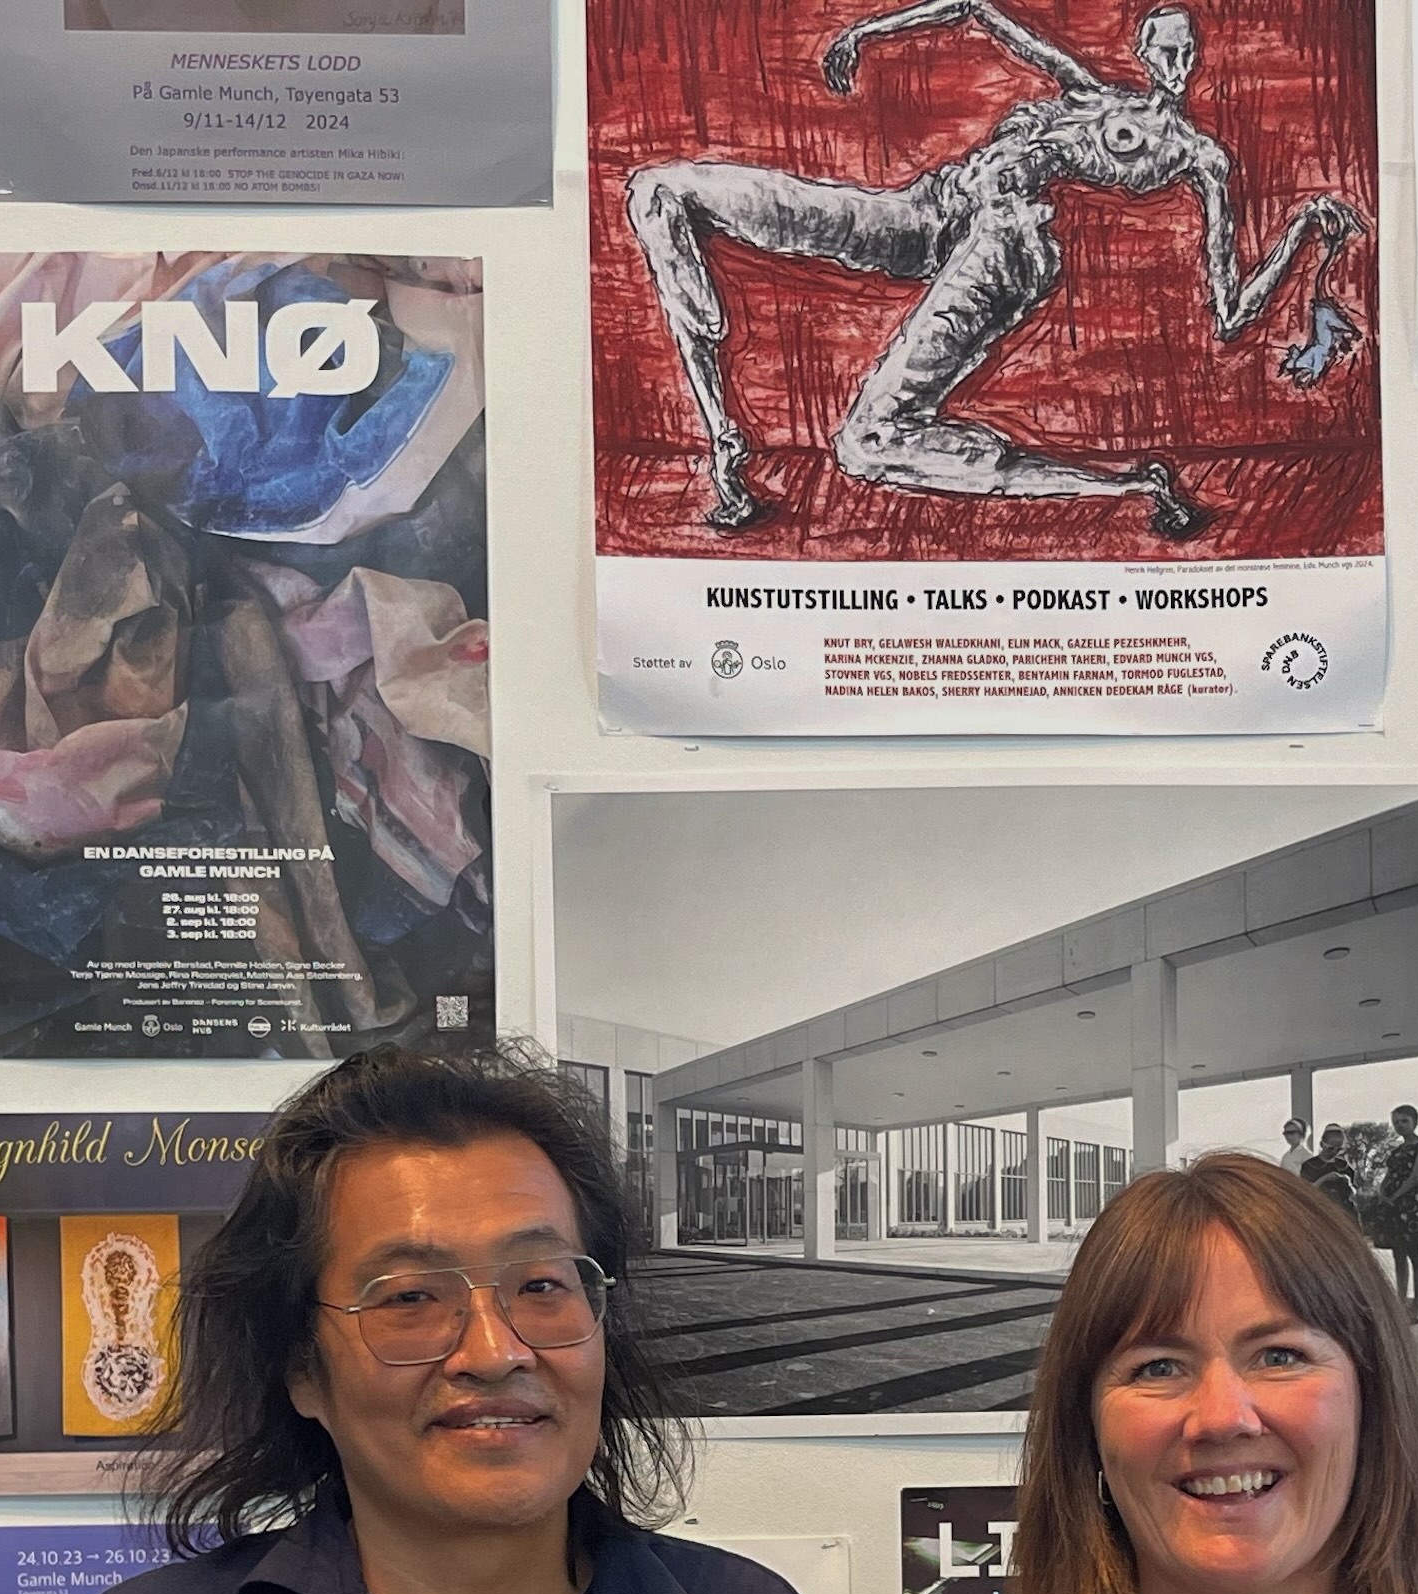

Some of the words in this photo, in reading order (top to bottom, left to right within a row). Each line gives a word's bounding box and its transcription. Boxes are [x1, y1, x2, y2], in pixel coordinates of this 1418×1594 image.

[171, 53, 300, 71] MENNESKETS
[307, 55, 361, 72] LODD
[133, 83, 152, 100] På
[159, 84, 212, 100] Gamle
[219, 85, 278, 104] Munch,
[286, 87, 373, 106] Tøyengata
[379, 88, 399, 103] 53
[21, 299, 380, 399] KNØ
[707, 588, 898, 611] KUNSTUTSTILLING
[924, 589, 987, 610] TALKS
[1012, 589, 1111, 610] PODKAST
[1135, 588, 1268, 610] WORKSHOPS
[824, 638, 850, 649] KNUT
[854, 638, 876, 651] BRY,
[879, 639, 932, 649] GELAWESH
[936, 638, 1002, 651] WALEDKHANI,
[1008, 638, 1029, 648] ELIN
[1034, 638, 1063, 651] MACK,
[1068, 638, 1110, 648] GAZELLE
[1114, 638, 1190, 651] PEZESHKMEHR,
[84, 847, 110, 859] EN
[113, 848, 305, 860] DANSEFORESTILLING
[308, 845, 335, 861] PÅ
[139, 866, 206, 878] GAMLE
[210, 866, 280, 878] MUNCH
[123, 1118, 266, 1167] Monse
[18, 1572, 66, 1587] Gamle
[71, 1571, 122, 1586] Munch
